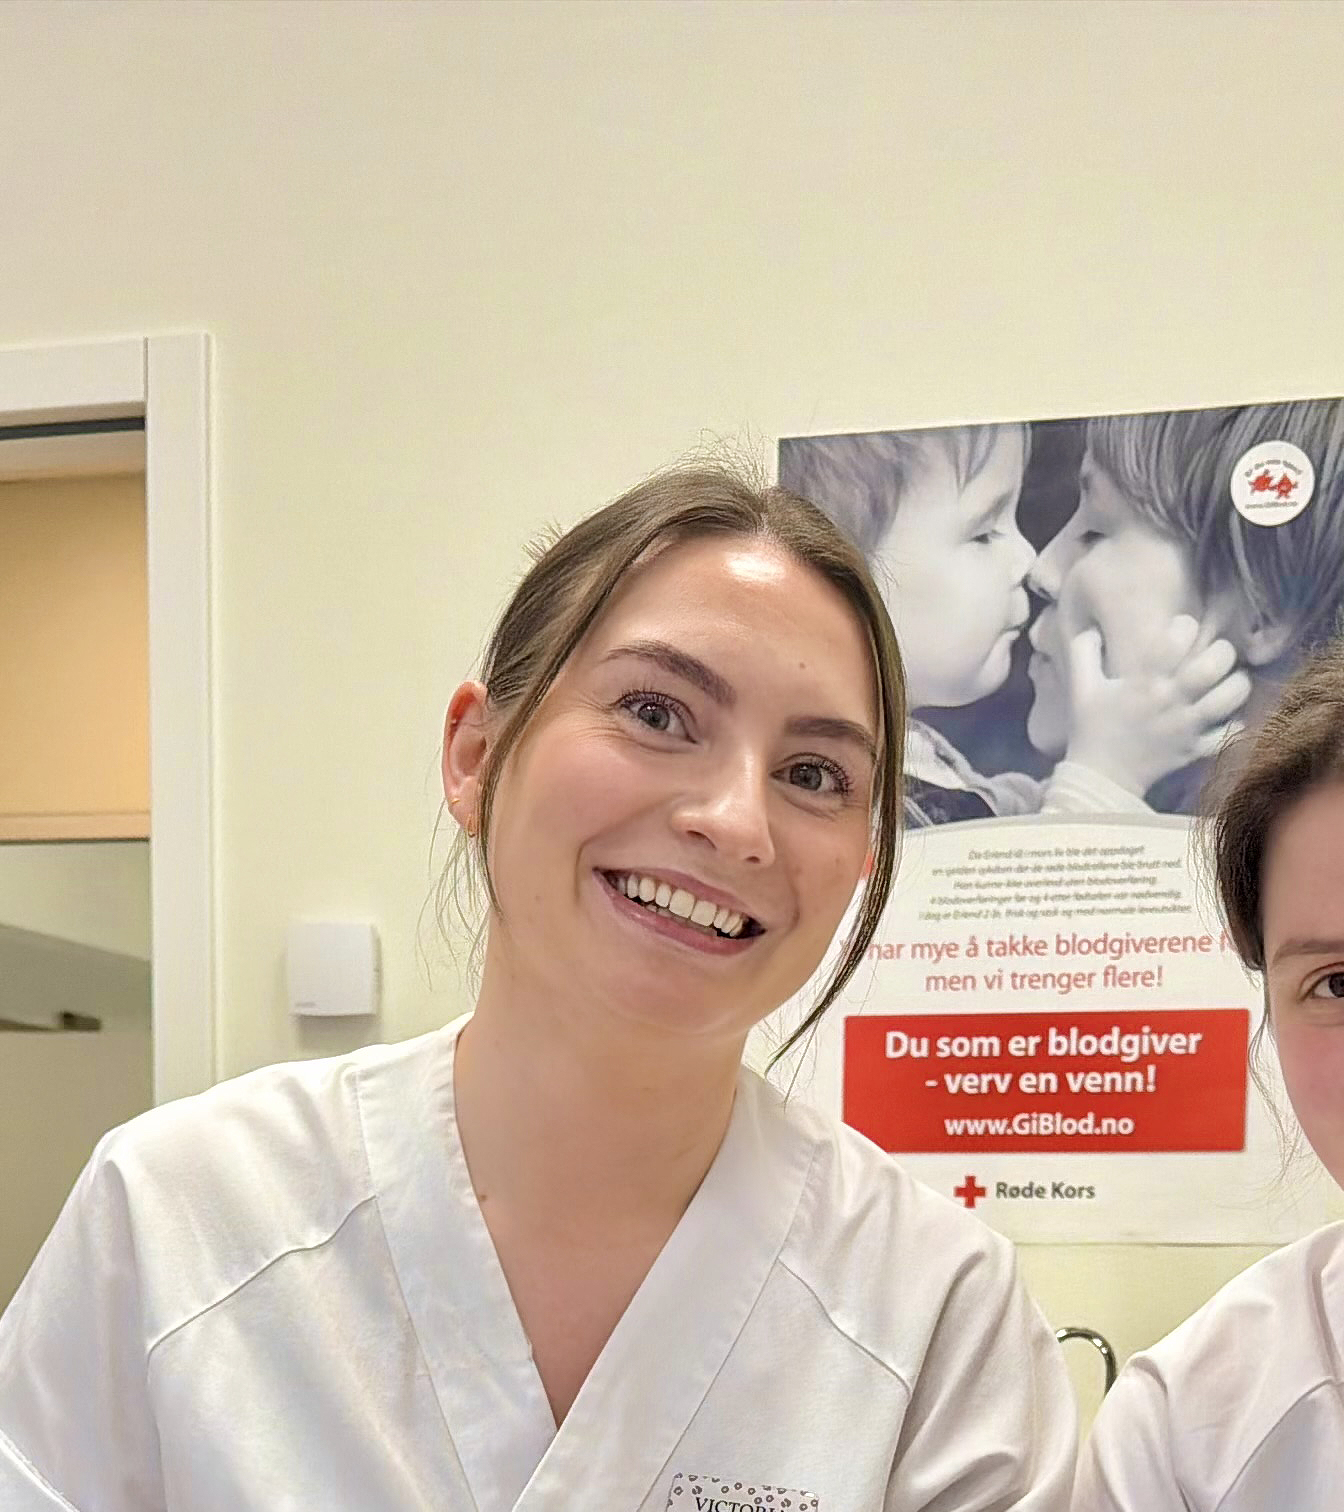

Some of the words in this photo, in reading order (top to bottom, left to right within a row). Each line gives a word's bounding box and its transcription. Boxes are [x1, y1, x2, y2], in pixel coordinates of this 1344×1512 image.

[911, 942, 958, 965] mye
[966, 934, 979, 957] å
[987, 933, 1048, 957] takke
[1056, 932, 1212, 962] blodgiverene
[925, 971, 977, 992] men
[984, 968, 1004, 990] vi
[1011, 969, 1097, 995] trenger
[1102, 965, 1164, 989] flere!
[885, 1031, 929, 1058] Du
[936, 1035, 1000, 1057] som
[1007, 1034, 1041, 1056] er
[1048, 1027, 1203, 1062] blodgiver
[945, 1070, 1012, 1094] verv
[1019, 1071, 1058, 1093] en
[1066, 1065, 1156, 1092] venn!
[945, 1112, 1135, 1137] www.GiBlod.no
[995, 1180, 1047, 1199] Røde
[1051, 1180, 1096, 1199] Kors
